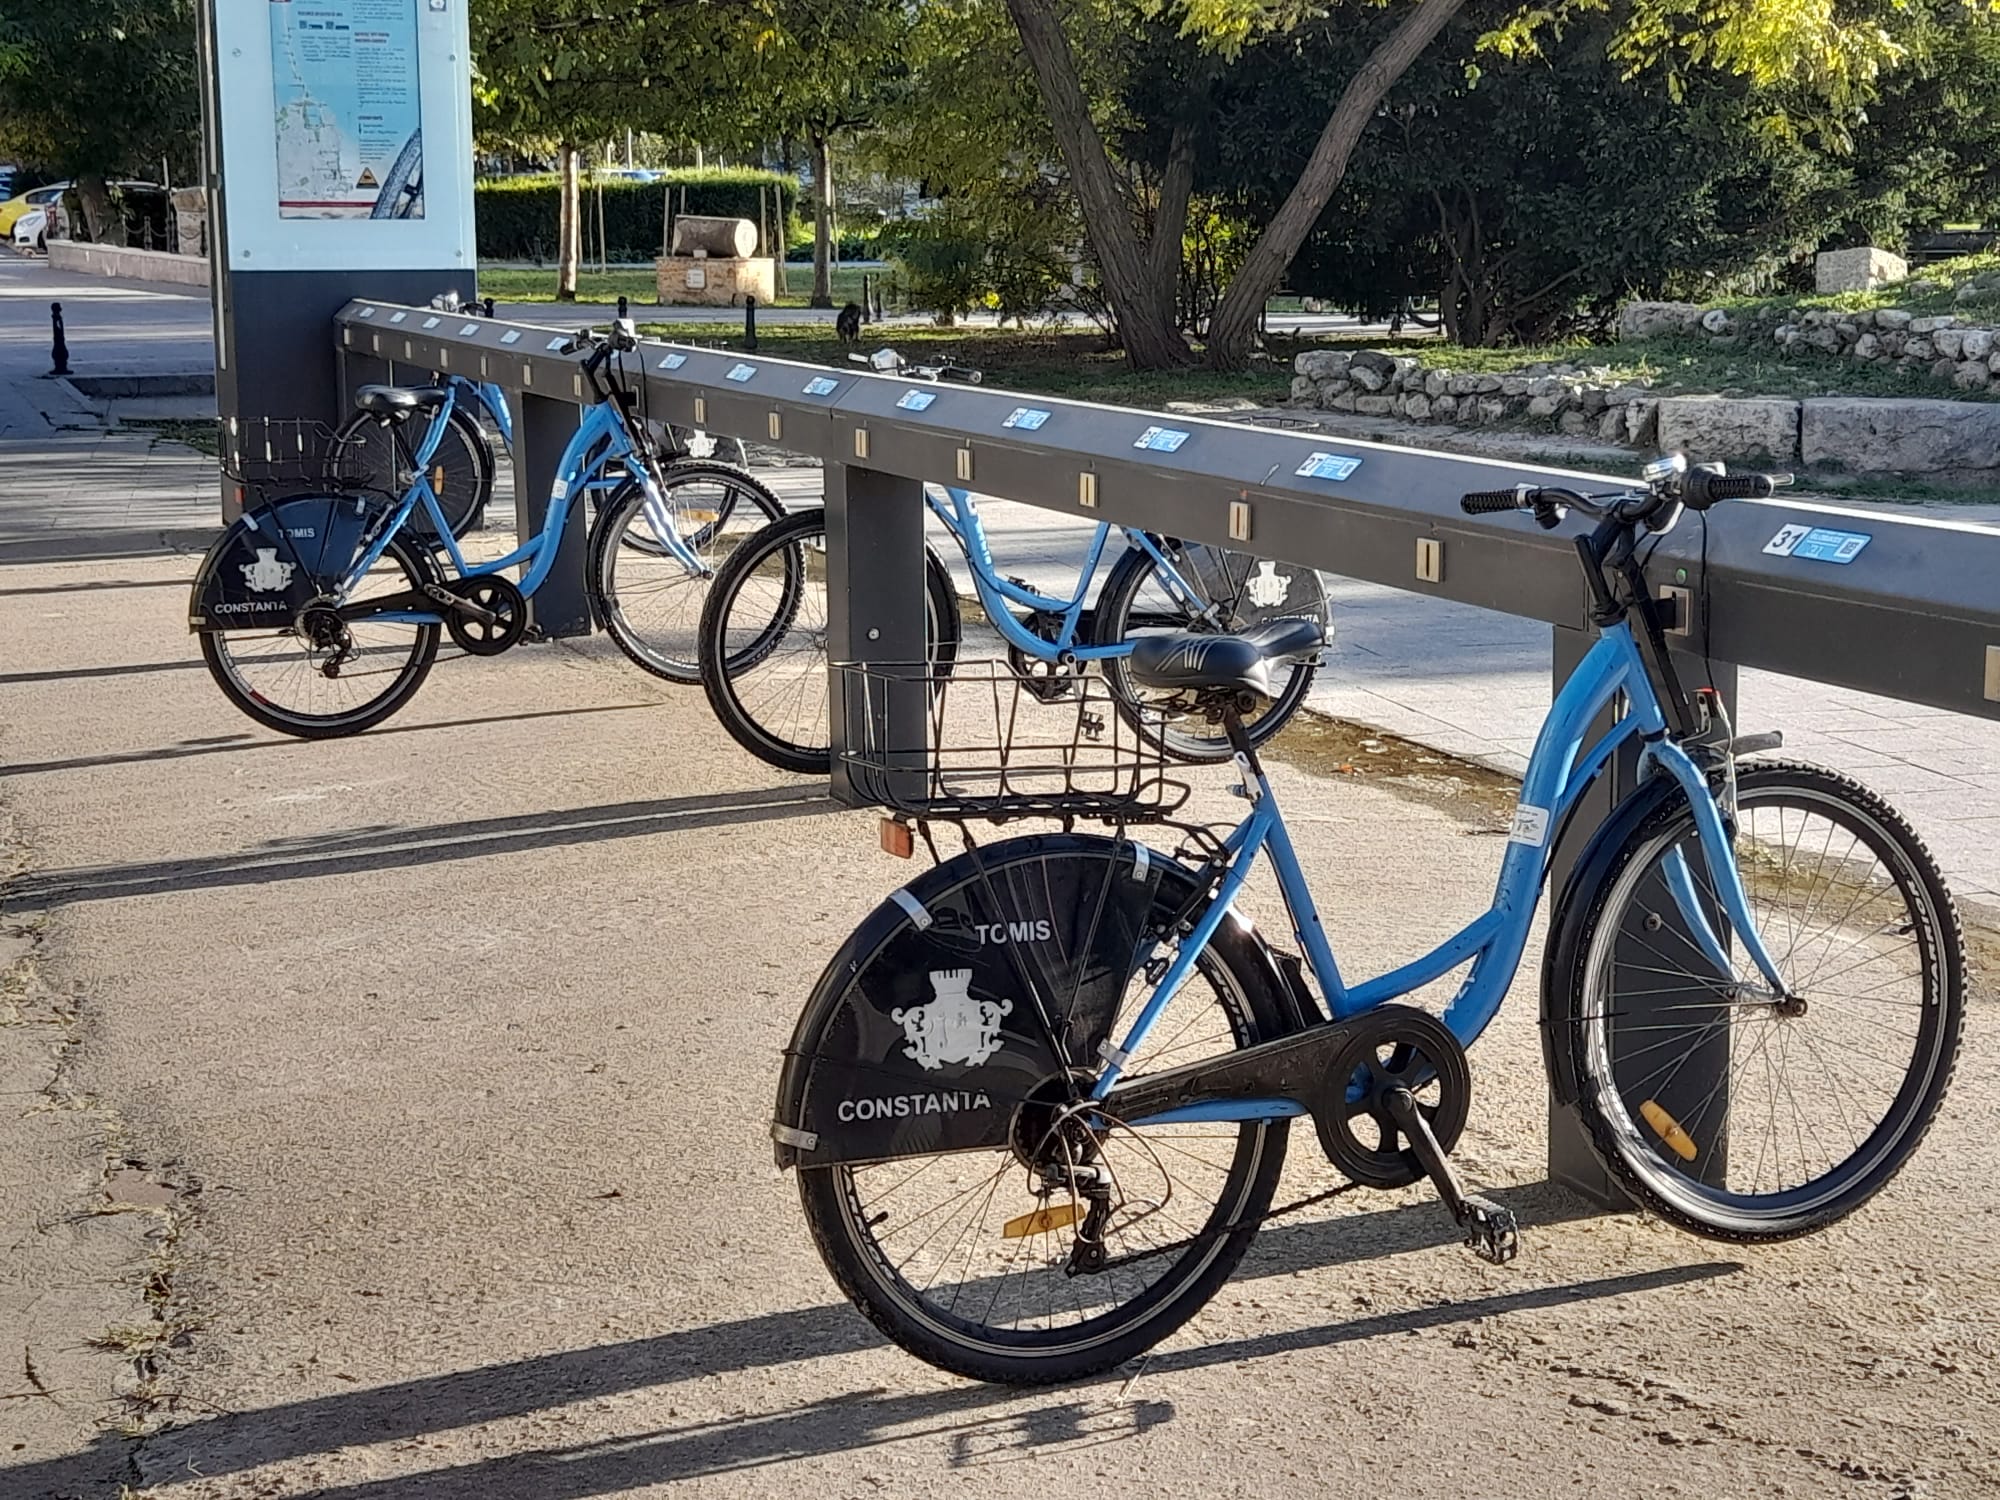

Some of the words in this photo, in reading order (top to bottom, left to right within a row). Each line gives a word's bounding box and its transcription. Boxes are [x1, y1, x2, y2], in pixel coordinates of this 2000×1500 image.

[1301, 457, 1324, 471] 27
[1772, 530, 1802, 549] 31
[975, 920, 1051, 945] TOMIS
[1906, 879, 1939, 1005] WARRIOR
[838, 1089, 992, 1122] CONSTANTA
